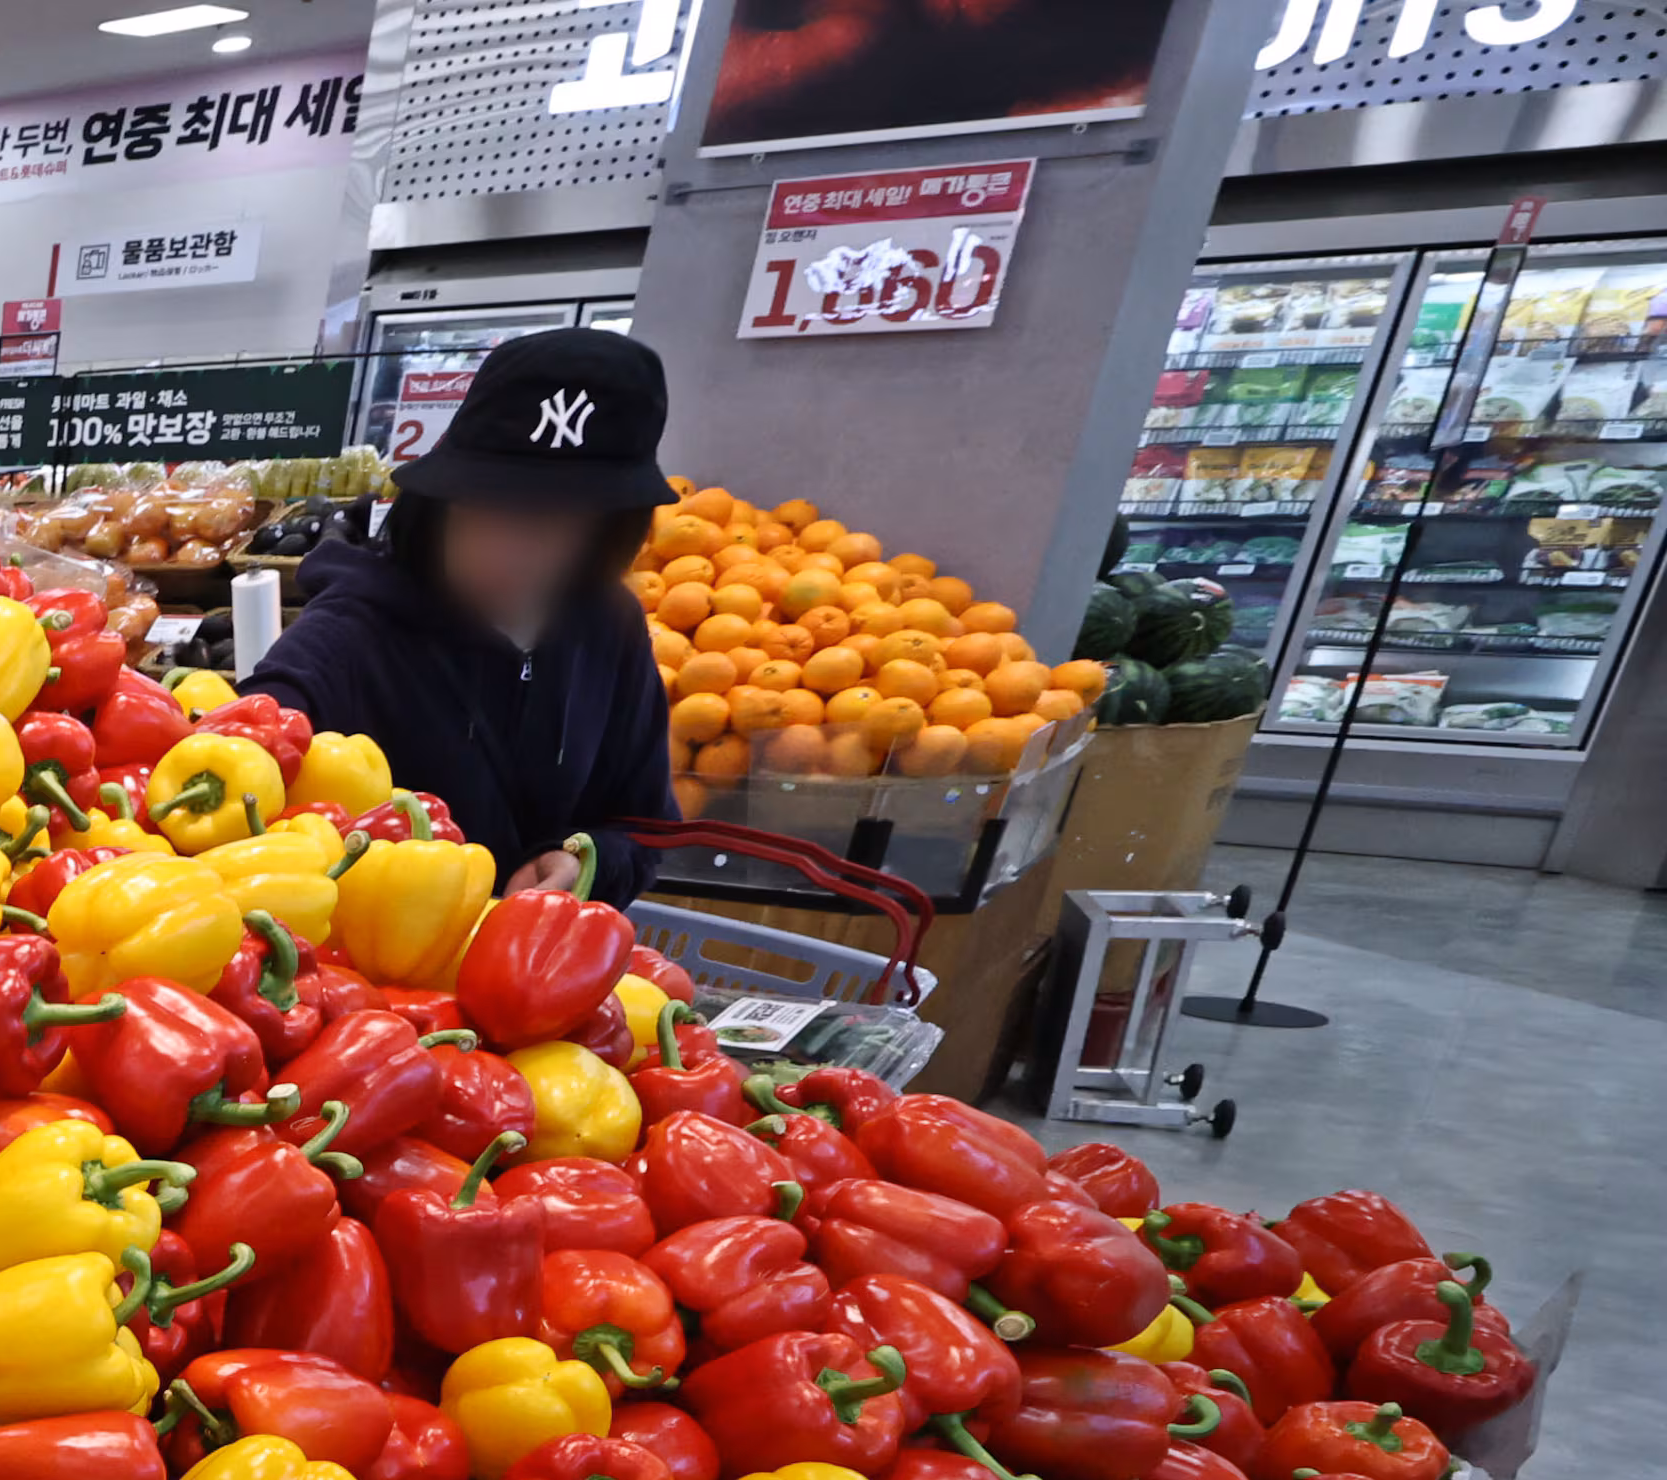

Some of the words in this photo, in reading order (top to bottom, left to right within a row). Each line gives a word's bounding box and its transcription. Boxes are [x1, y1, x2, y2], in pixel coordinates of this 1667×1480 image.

[12, 118, 73, 160] 두번,
[82, 103, 172, 166] 연중
[176, 85, 282, 151] 최대
[783, 193, 822, 215] 연중
[822, 189, 862, 210] 최대
[867, 185, 913, 206] 세일!
[919, 171, 1013, 208] 메가통큰
[121, 230, 238, 266] 물품보관함
[127, 411, 217, 448] 맛보장
[529, 387, 596, 449] NY
